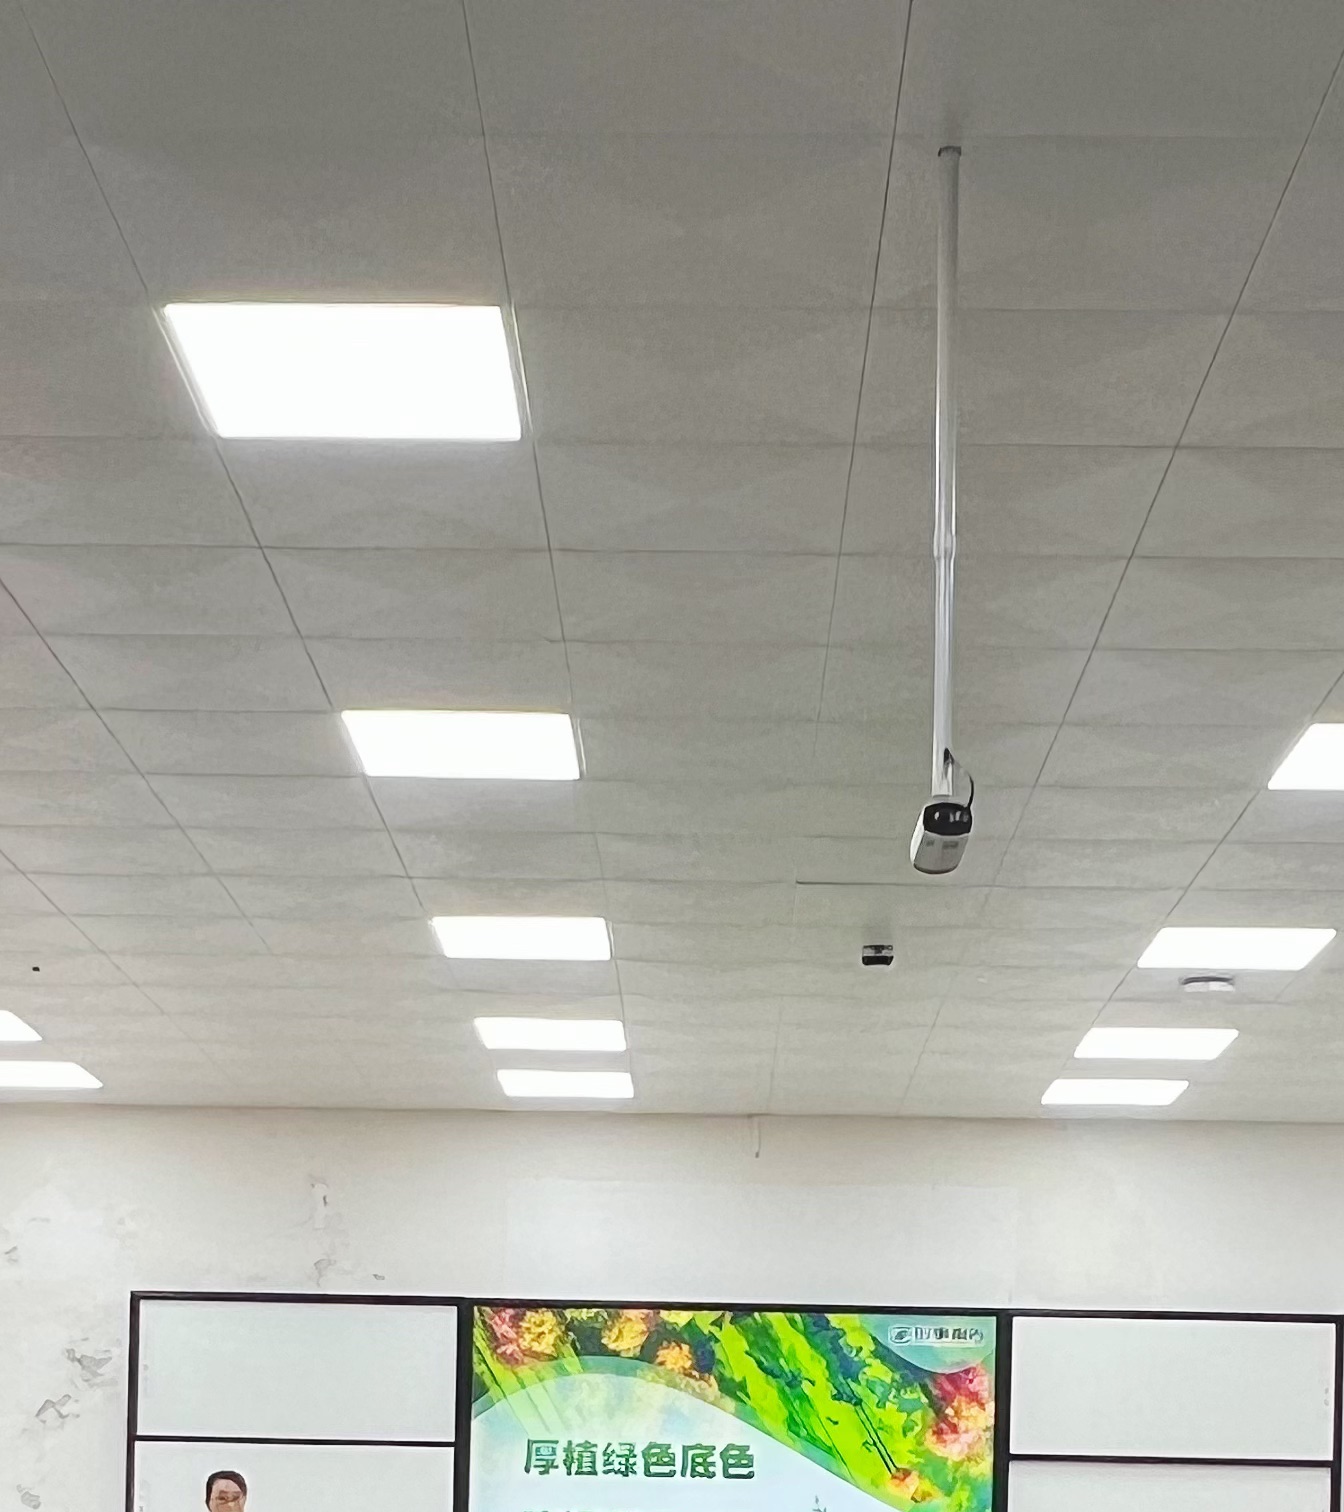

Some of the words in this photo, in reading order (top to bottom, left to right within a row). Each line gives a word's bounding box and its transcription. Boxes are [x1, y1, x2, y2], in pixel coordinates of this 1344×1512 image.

[524, 1438, 755, 1479] 厚植绿色底色
